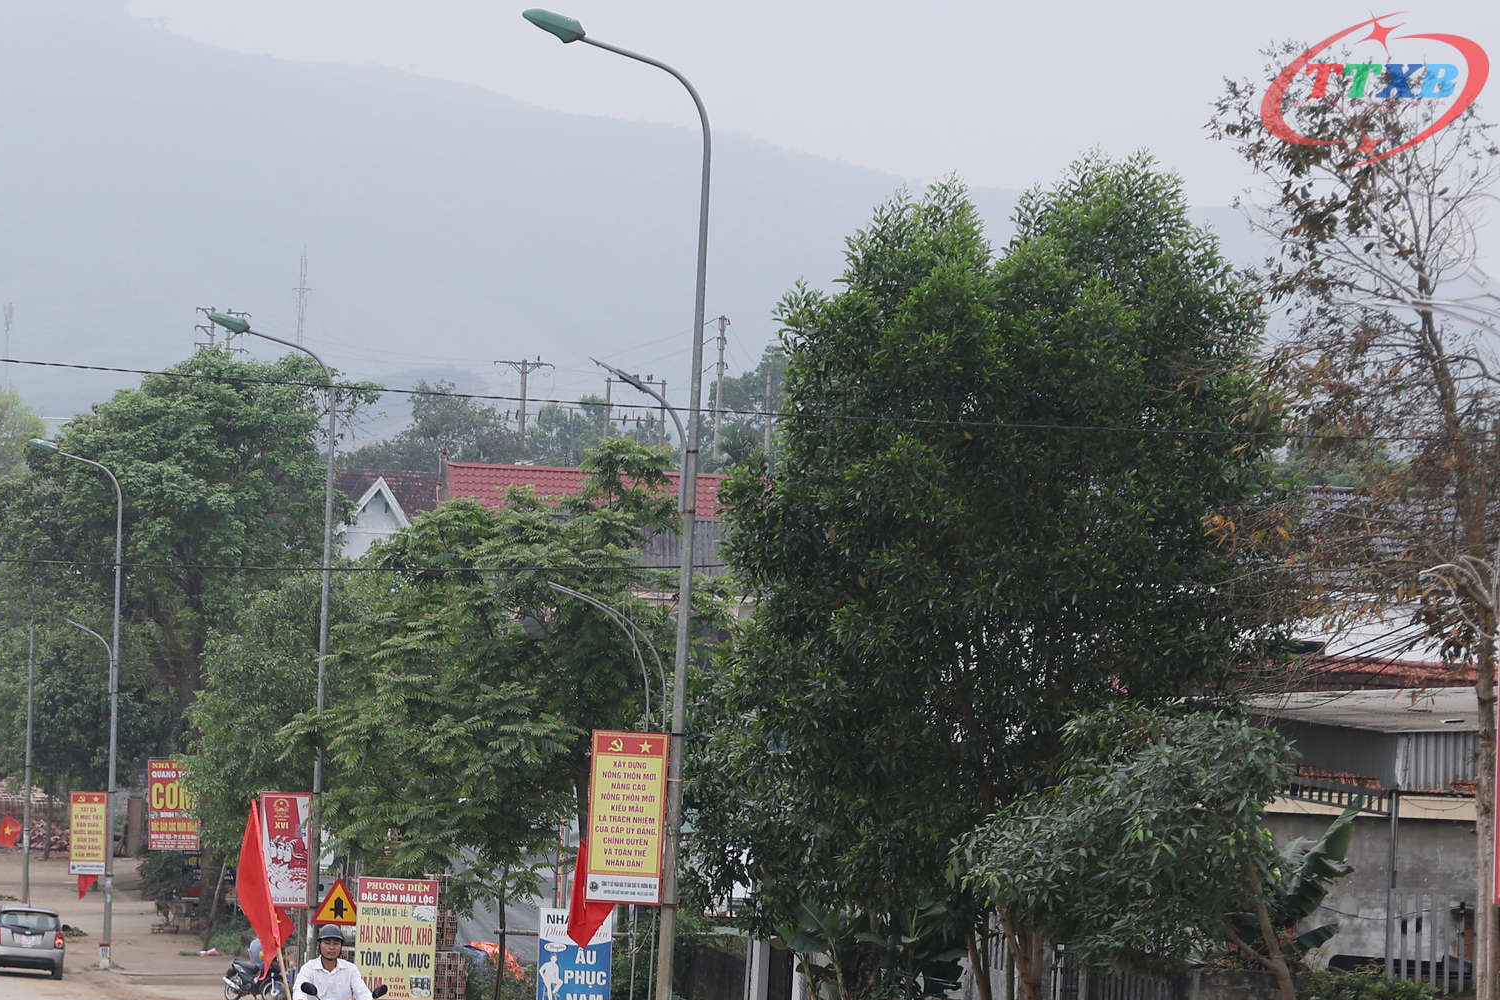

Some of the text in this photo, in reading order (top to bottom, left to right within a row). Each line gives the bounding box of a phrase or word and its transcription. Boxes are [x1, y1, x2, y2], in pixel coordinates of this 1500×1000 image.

[613, 759, 647, 770] XÂY DỰNG
[602, 770, 656, 781] NÔNG THÔN MỚI
[611, 781, 646, 791] NÂNG CAO
[601, 792, 655, 803] NÔNG THÔN MỚI
[611, 802, 644, 813] KIỂU MẪU
[599, 813, 655, 826] LÀ TRÁCH NHIỆM
[595, 823, 657, 837] CỦA CẤP UỶ ĐẢNG,
[603, 835, 648, 847] CHÍNH QUYỀN
[604, 847, 647, 857] VÀ TOÀN THỂ
[606, 857, 643, 868] NHÂN DÂN!
[367, 881, 430, 893] PHƯƠNG DIỆN
[362, 891, 434, 904] ĐẶC SẢN HẬU LỘC
[362, 906, 381, 916] CHUYÊN
[382, 906, 391, 917] BÁN
[392, 906, 398, 917] SỈ
[360, 918, 433, 948] HẢI SẢN TƯƠI, KHÔ
[360, 948, 430, 972] TÔM, CÁ, MỰC
[575, 948, 596, 965] ÂU
[390, 975, 405, 983] CỐT
[564, 970, 606, 988] PHỤC
